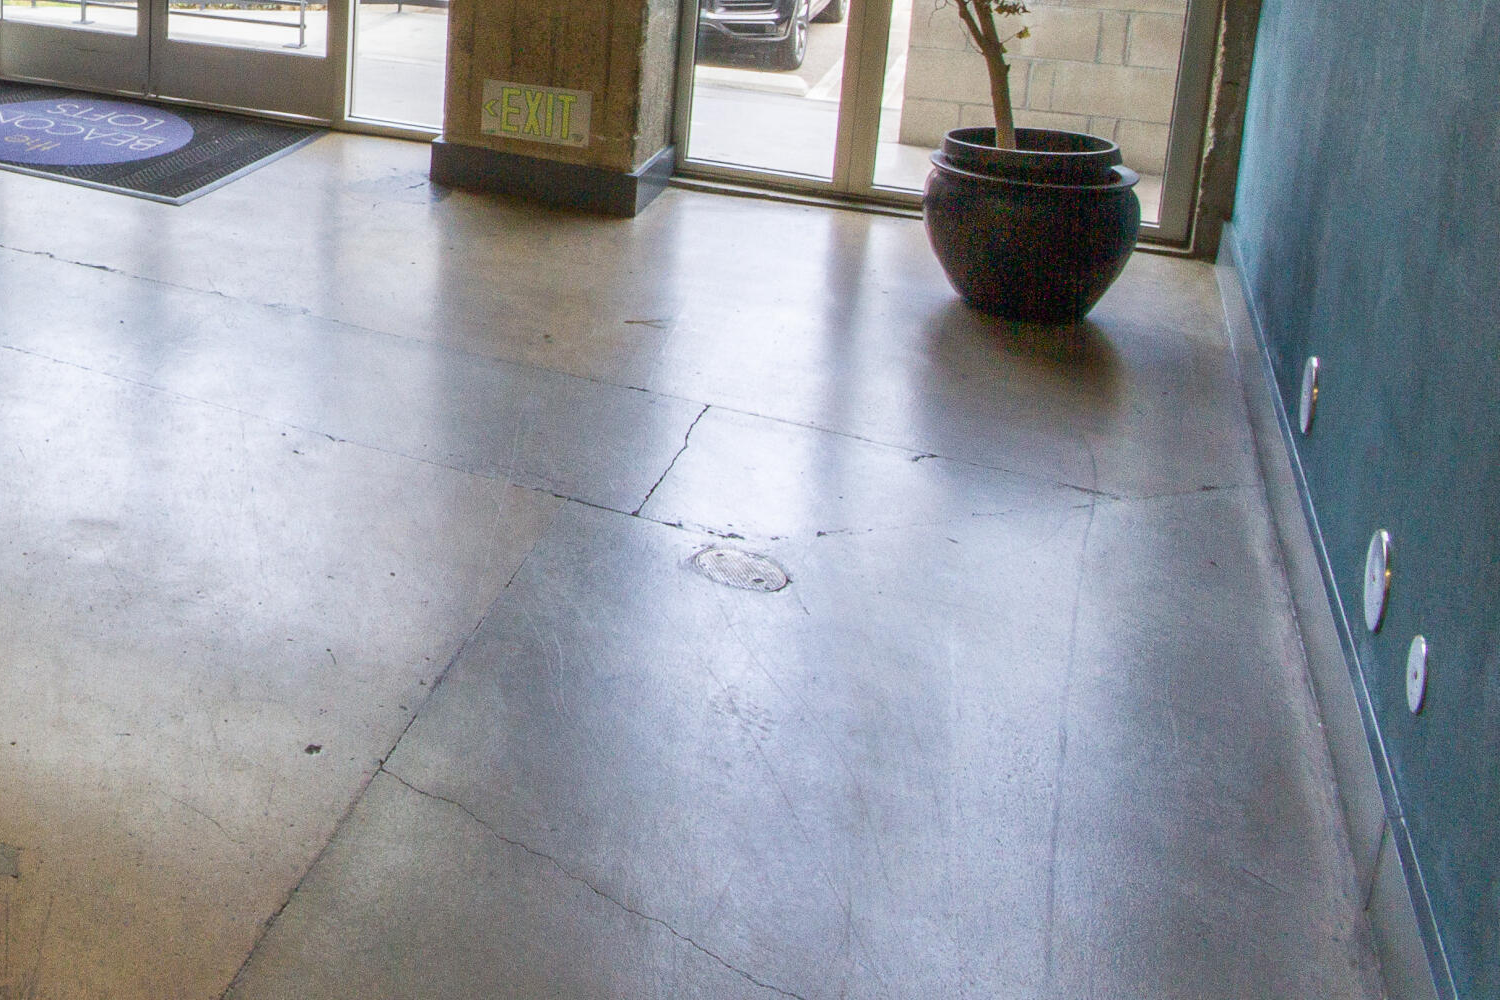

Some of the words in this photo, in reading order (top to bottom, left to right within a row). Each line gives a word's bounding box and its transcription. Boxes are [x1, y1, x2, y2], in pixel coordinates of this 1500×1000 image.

[46, 102, 166, 131] LOFTS
[501, 87, 578, 139] EXIT
[3, 133, 62, 152] the
